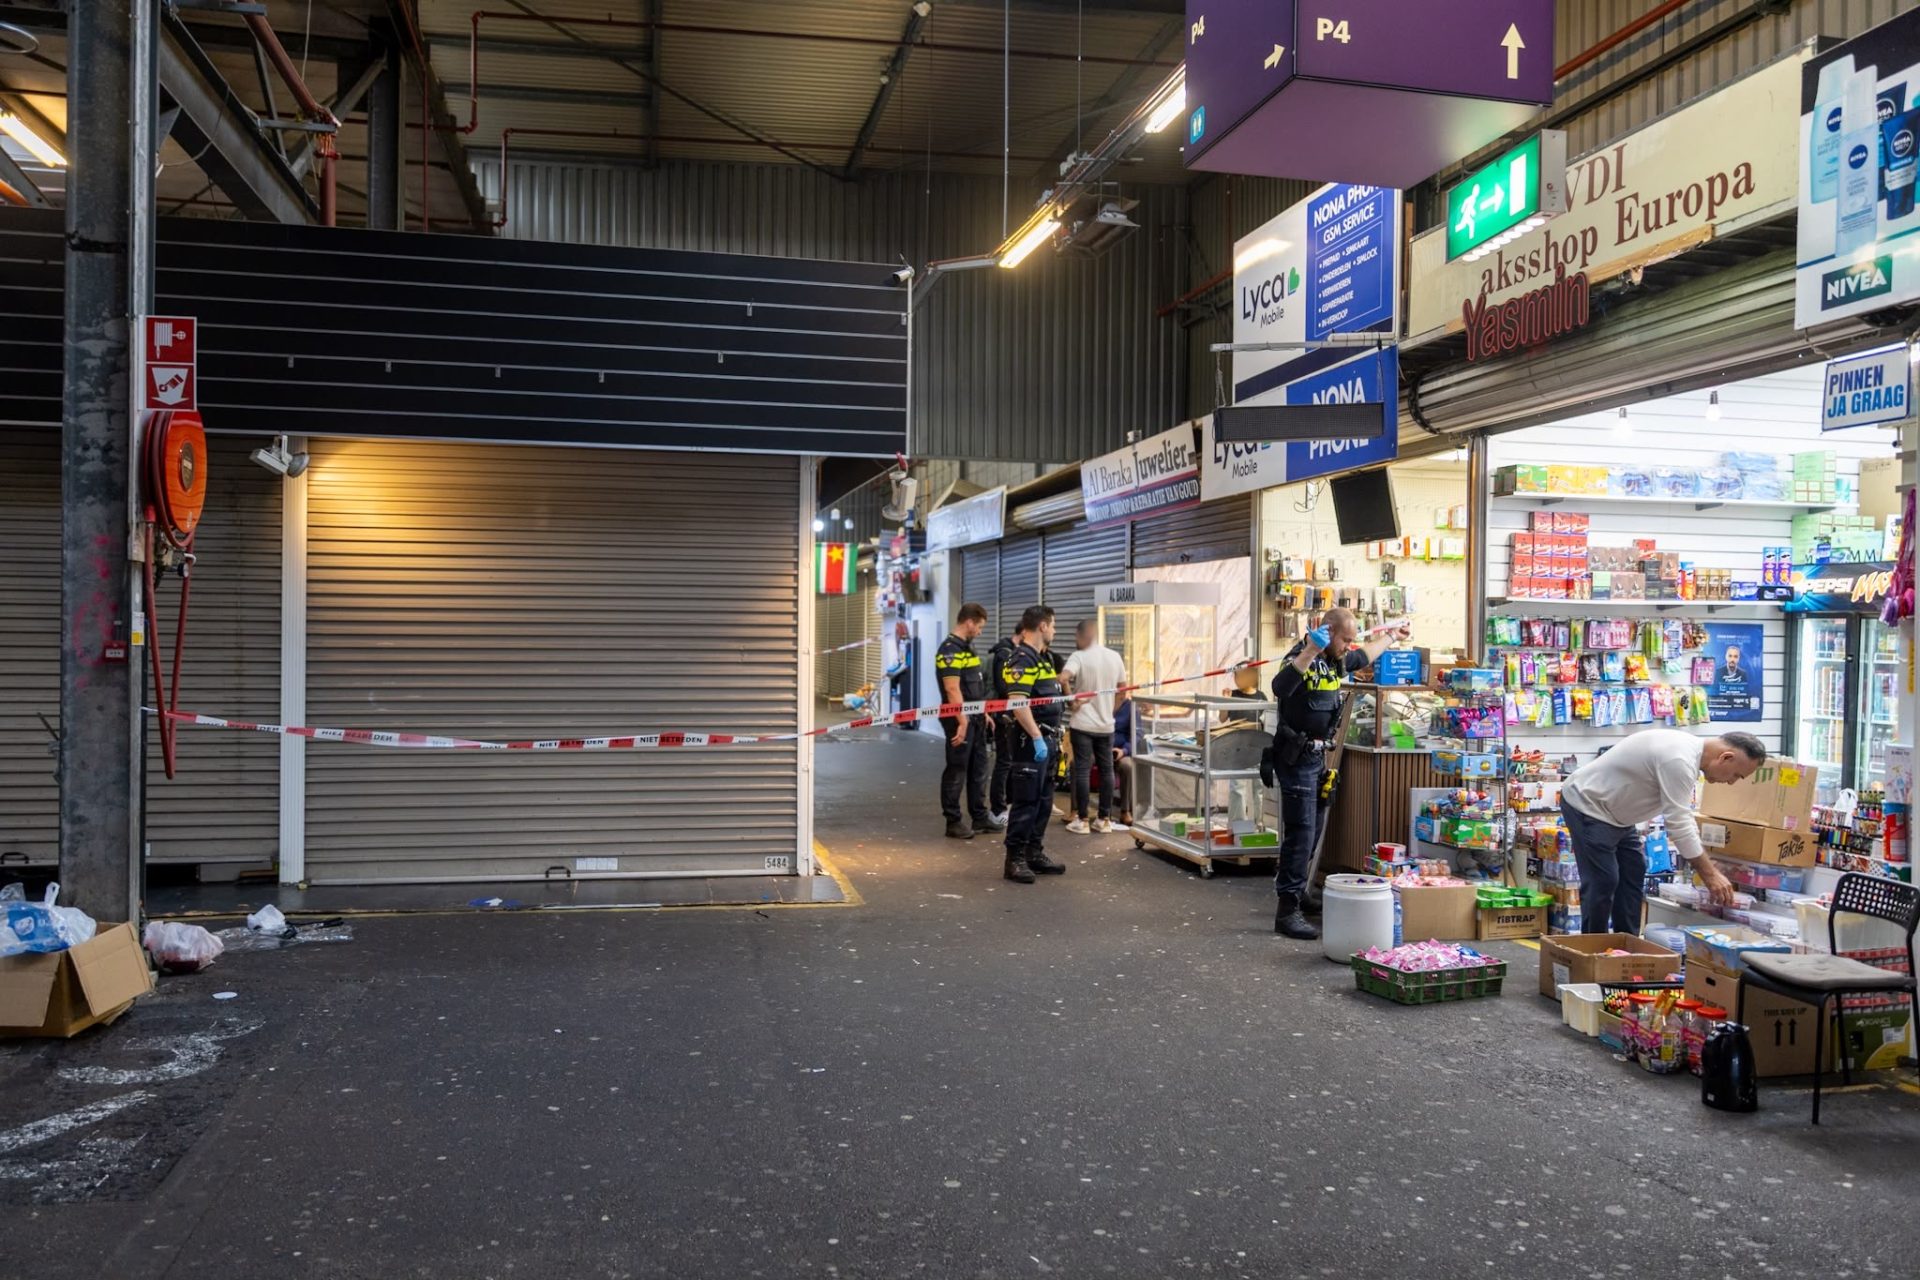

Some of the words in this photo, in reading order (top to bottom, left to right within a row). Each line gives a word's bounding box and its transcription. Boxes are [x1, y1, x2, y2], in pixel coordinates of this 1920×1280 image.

[1191, 15, 1205, 45] P4
[1316, 17, 1351, 44] P4
[1849, 151, 1867, 163] NIVEA
[1314, 194, 1346, 228] NONA
[1347, 185, 1379, 208] PHO
[1615, 161, 1756, 247] Europa
[1323, 223, 1341, 244] GSM
[1343, 202, 1375, 234] SERVICE
[1242, 271, 1285, 322] Lyca
[1827, 268, 1887, 301] NIVEA
[1260, 307, 1285, 329] Mobile
[1462, 262, 1590, 362] Yasmin
[1828, 364, 1884, 396] PINNEN
[1828, 395, 1847, 418] JA
[1851, 384, 1904, 415] GRAAG
[1099, 458, 1134, 493] Baraka
[1132, 440, 1188, 490] Juwelier
[1232, 460, 1258, 479] Mobile
[1178, 479, 1199, 500] GOUD
[1109, 588, 1115, 602] AL
[1116, 587, 1136, 602] BARAKA
[1804, 577, 1854, 595] PEPSI
[940, 704, 980, 714] BETREDEN
[765, 857, 787, 868] 5484
[1778, 840, 1805, 863] Takis
